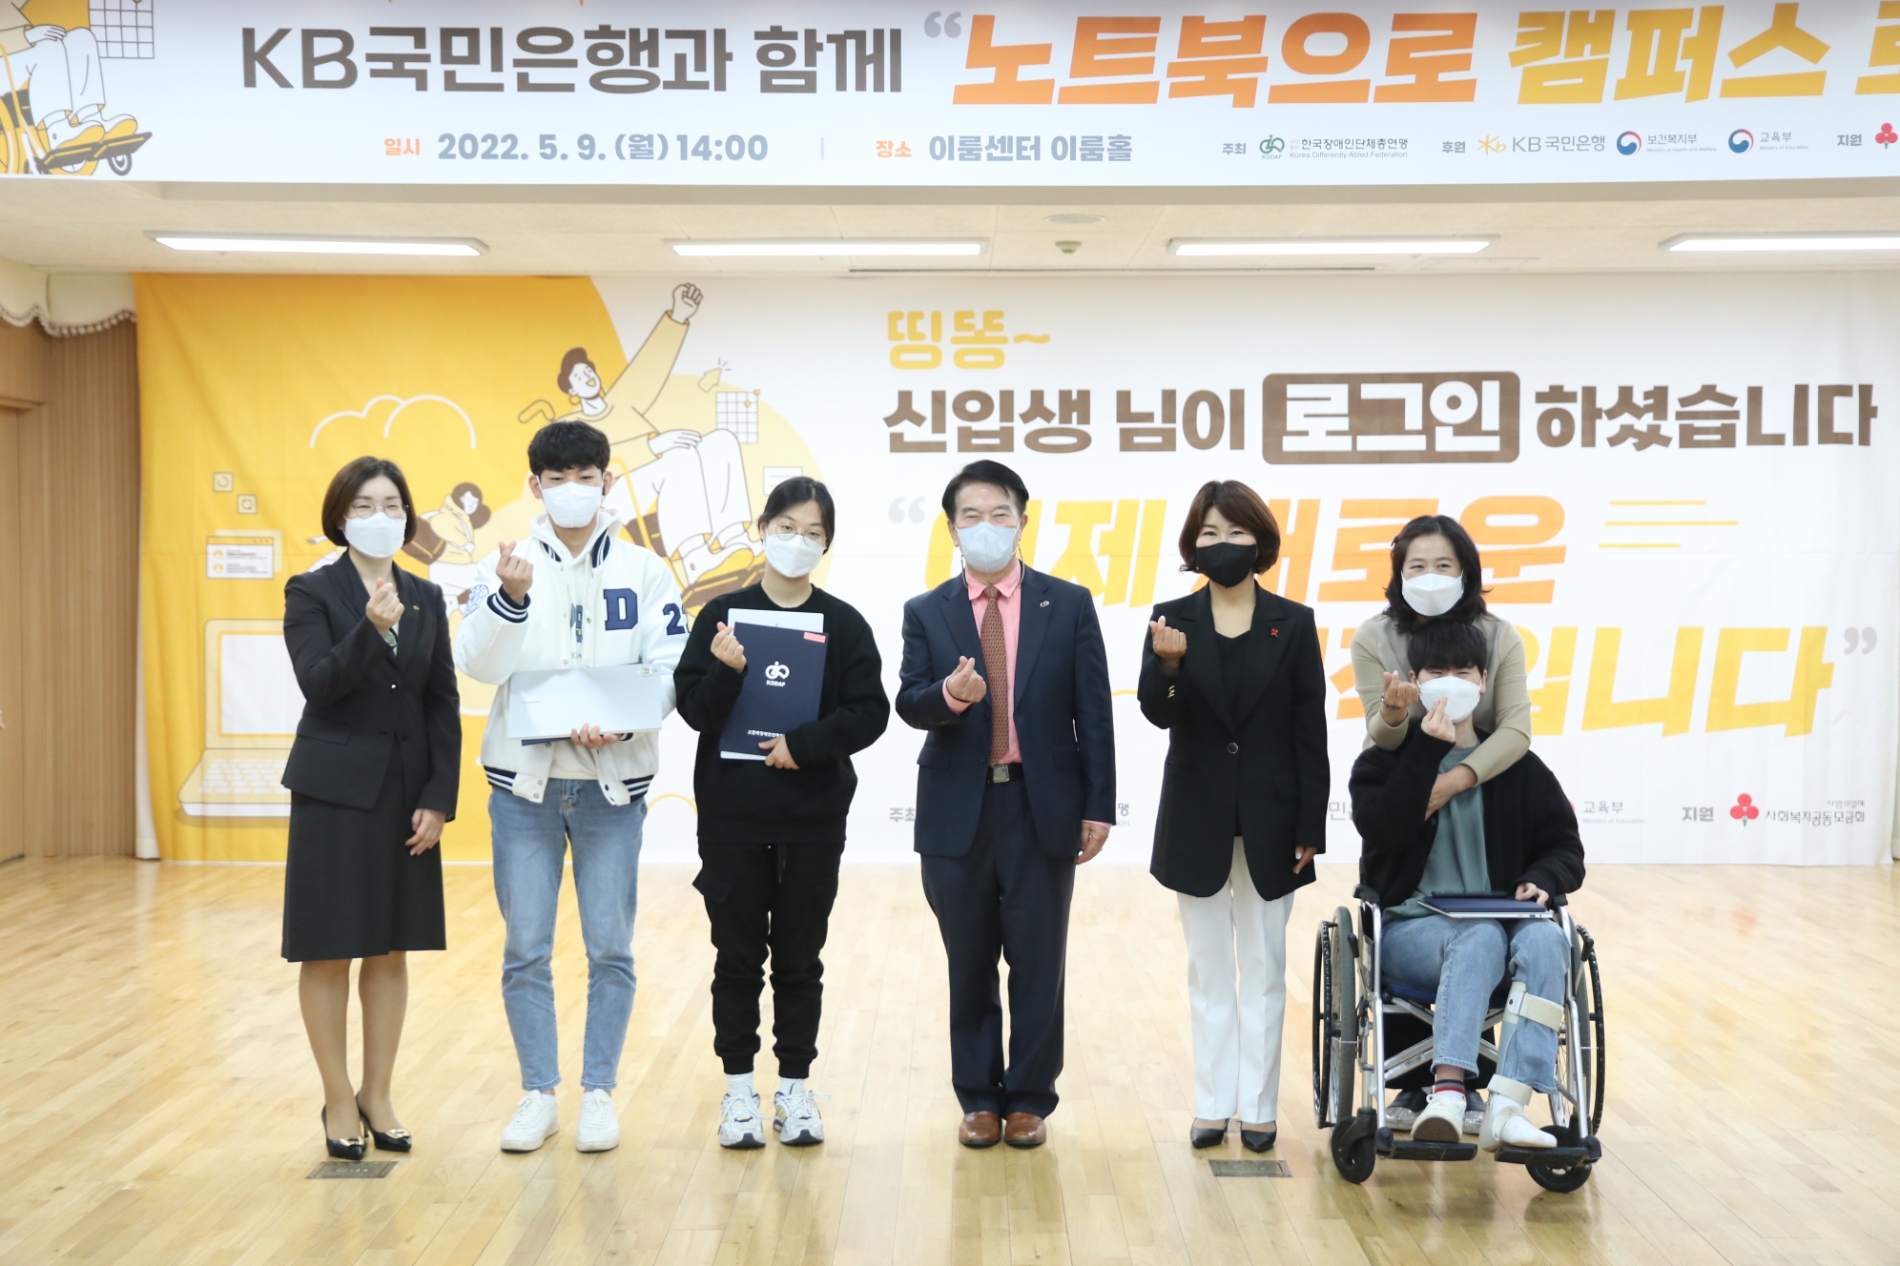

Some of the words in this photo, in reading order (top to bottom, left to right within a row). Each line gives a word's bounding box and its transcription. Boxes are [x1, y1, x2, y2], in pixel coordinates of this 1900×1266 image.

[241, 25, 733, 94] KB국민은행과
[754, 25, 901, 94] 함께
[1508, 2, 1831, 104] 캠퍼스
[1301, 138, 1408, 150] 한국장애인단체총연맹
[1512, 137, 1541, 152] KB
[1545, 135, 1606, 152] 국민은행
[1647, 133, 1698, 145] 보건복지부
[1760, 131, 1793, 143] 교육부
[1837, 134, 1862, 146] 지원
[384, 137, 421, 156] 일시
[438, 133, 528, 160] 2022.
[538, 133, 568, 160] 5.
[577, 133, 606, 160] 9.
[614, 133, 669, 161] (월)
[677, 134, 768, 162] 14:00
[876, 140, 912, 158] 장소
[929, 135, 1042, 162] 이룸센터
[1051, 135, 1132, 162] 이룸홀
[1223, 143, 1246, 155] 주최
[1442, 141, 1466, 153] 후원
[1312, 151, 1347, 159] Differently
[887, 310, 1051, 370] 띵똥~
[882, 389, 1092, 454] 신입생
[1116, 389, 1245, 453] 님이
[1282, 379, 1501, 452] 로그인
[1535, 383, 1879, 452] 하셨습니다
[603, 588, 638, 631] D
[1583, 801, 1624, 814] 교육부
[1682, 807, 1714, 822] 지원
[1765, 810, 1865, 827] 사회복지공동모금회
